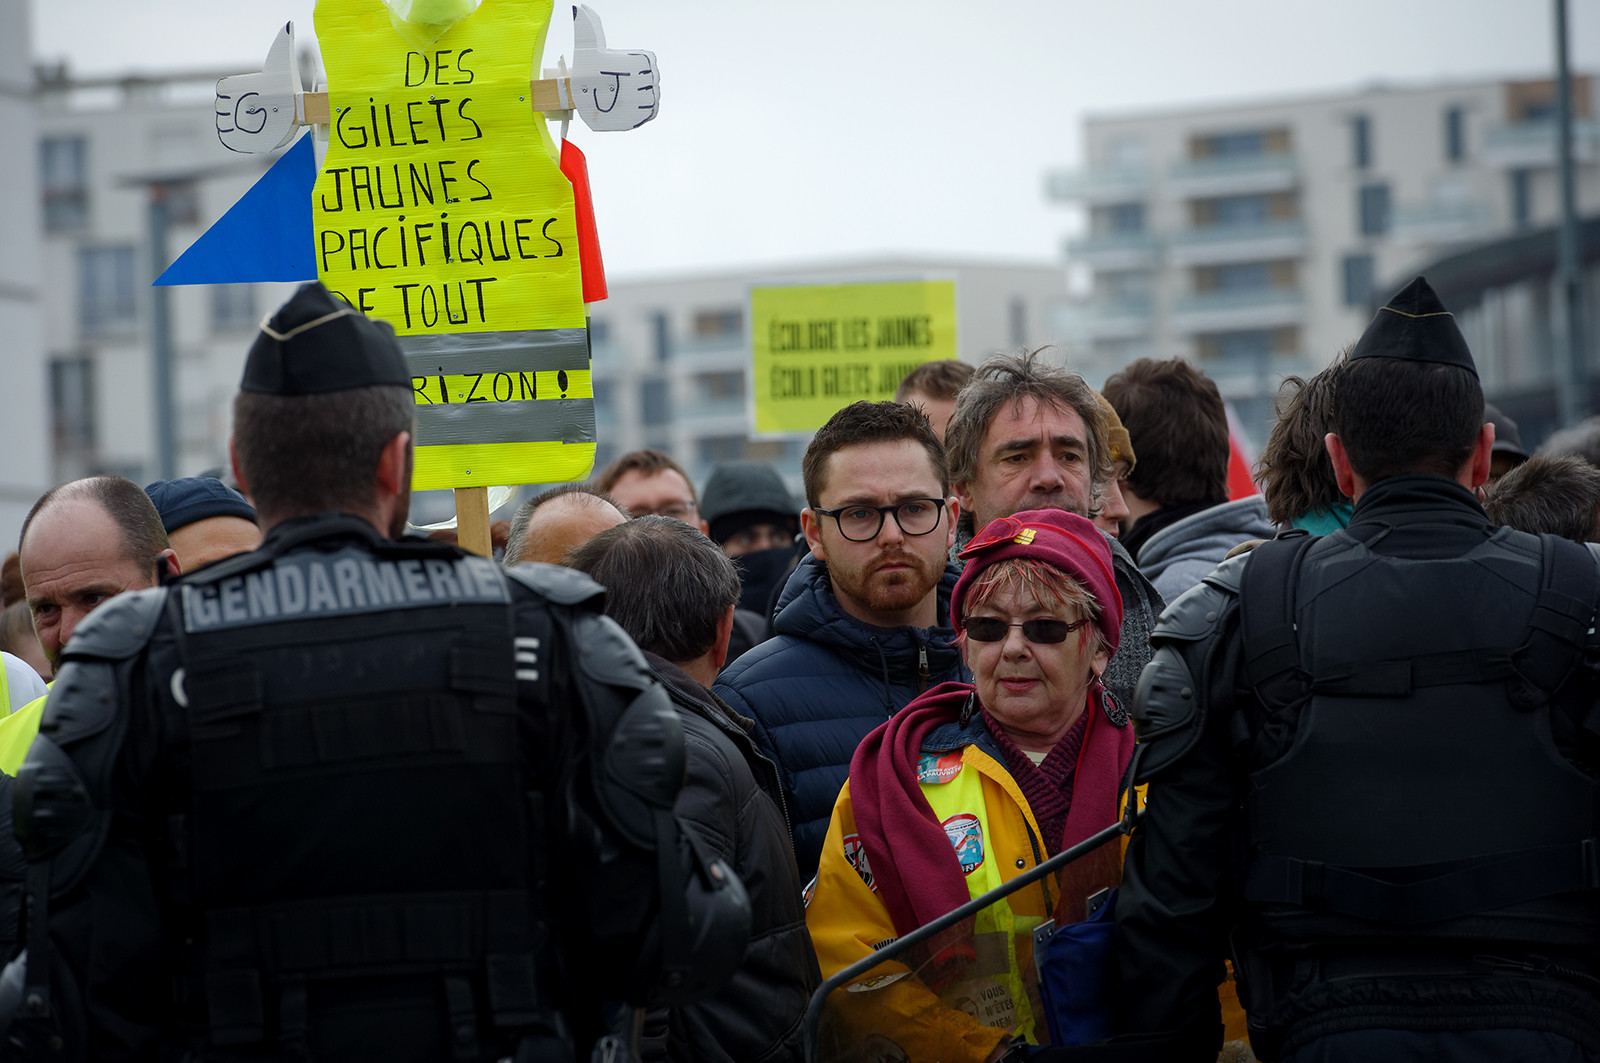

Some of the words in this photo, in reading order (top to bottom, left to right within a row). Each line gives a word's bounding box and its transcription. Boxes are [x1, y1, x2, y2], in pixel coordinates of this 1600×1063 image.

[405, 49, 474, 87] DES
[234, 92, 268, 134] G
[593, 71, 630, 113] J
[321, 160, 492, 212] JAUNES
[394, 277, 498, 329] TOUT
[842, 316, 869, 349] LES
[876, 313, 933, 348] JAUNES
[193, 557, 501, 624] GENDARMERIE
[981, 985, 1005, 1001] VOUS
